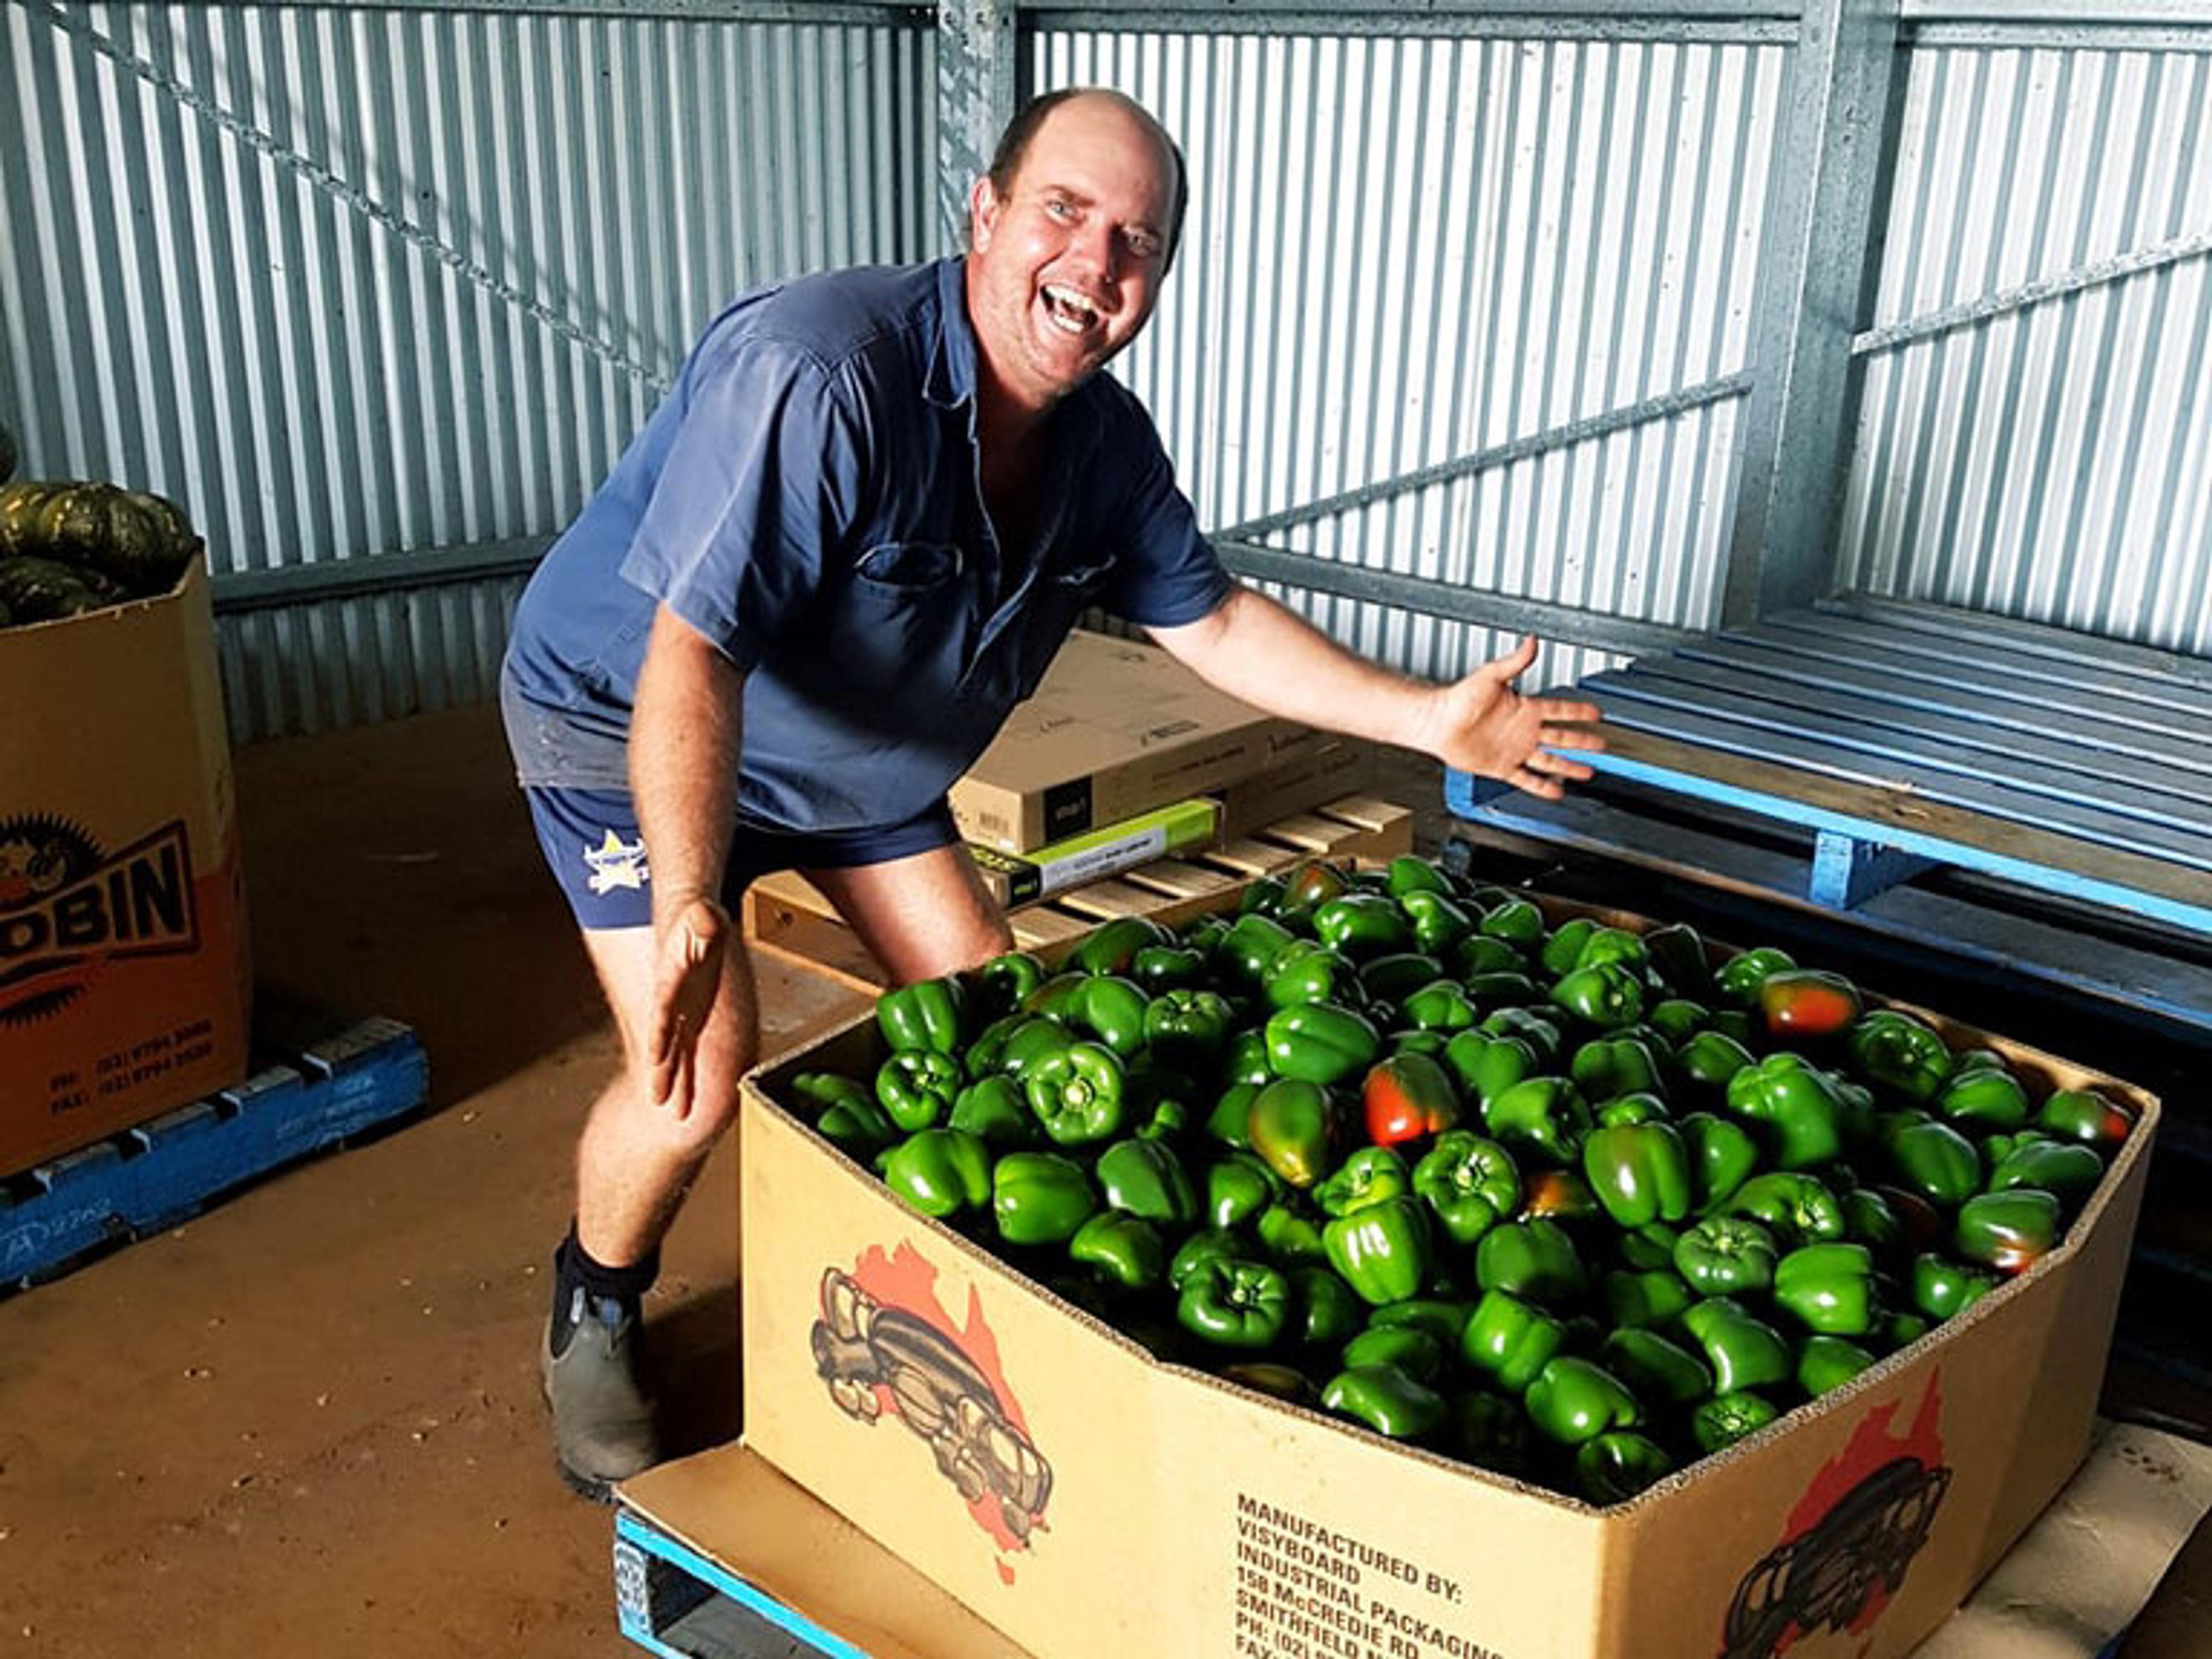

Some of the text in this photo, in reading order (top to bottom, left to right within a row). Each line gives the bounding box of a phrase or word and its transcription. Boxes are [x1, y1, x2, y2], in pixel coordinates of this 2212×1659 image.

[1237, 1493, 1462, 1605] MANUFACTURED BY:
[1237, 1517, 1361, 1585] VISYBOARD
[1237, 1540, 1365, 1614] INDUSTRIAL
[1236, 1588, 1359, 1659] SMITHFIELD
[1236, 1611, 1268, 1642] PH:
[1237, 1566, 1419, 1659] 158 McCREDIE RD
